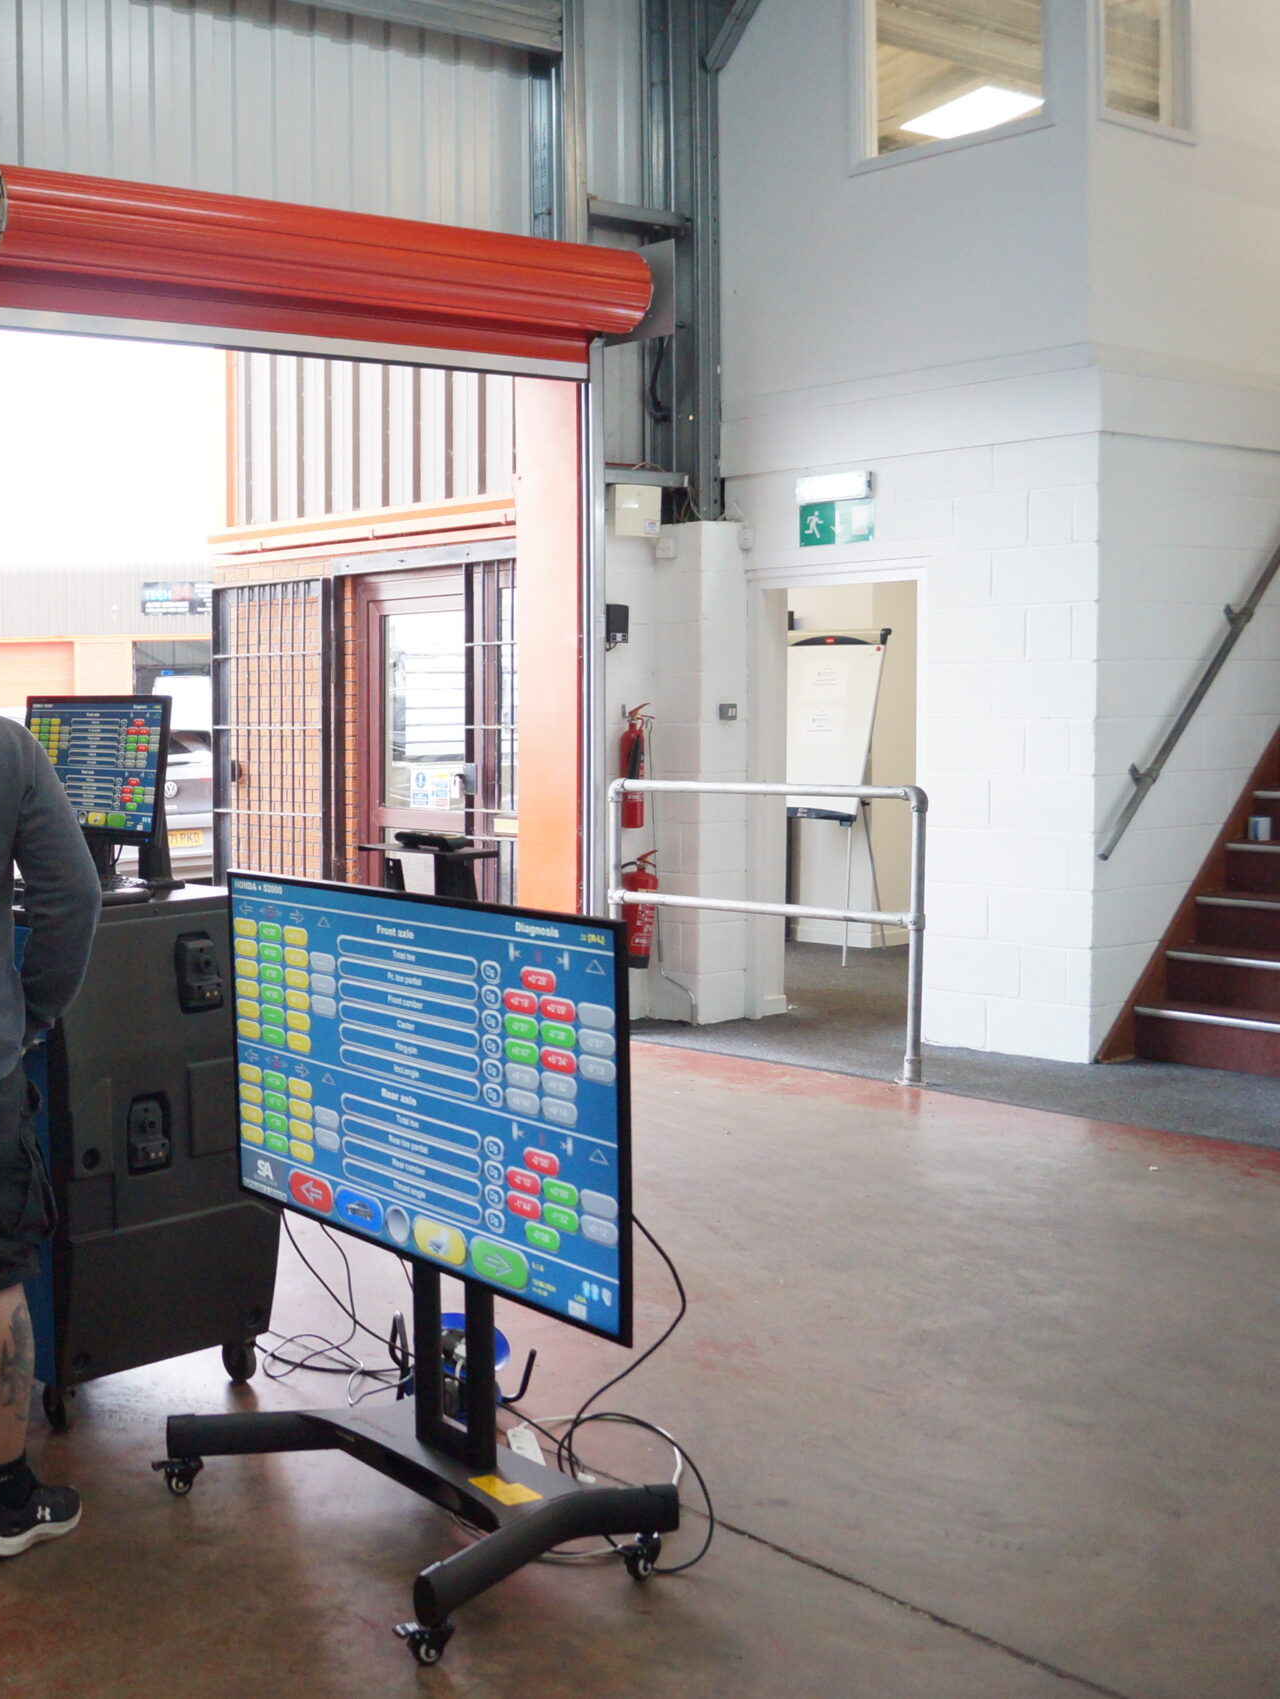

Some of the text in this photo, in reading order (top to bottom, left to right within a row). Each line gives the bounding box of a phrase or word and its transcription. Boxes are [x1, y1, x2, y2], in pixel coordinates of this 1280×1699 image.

[235, 880, 283, 895] HONDA S2000
[376, 924, 415, 939] Front axle
[515, 921, 559, 938] Diagnosis
[381, 1087, 417, 1106] Rear axle
[257, 1159, 274, 1180] SA
